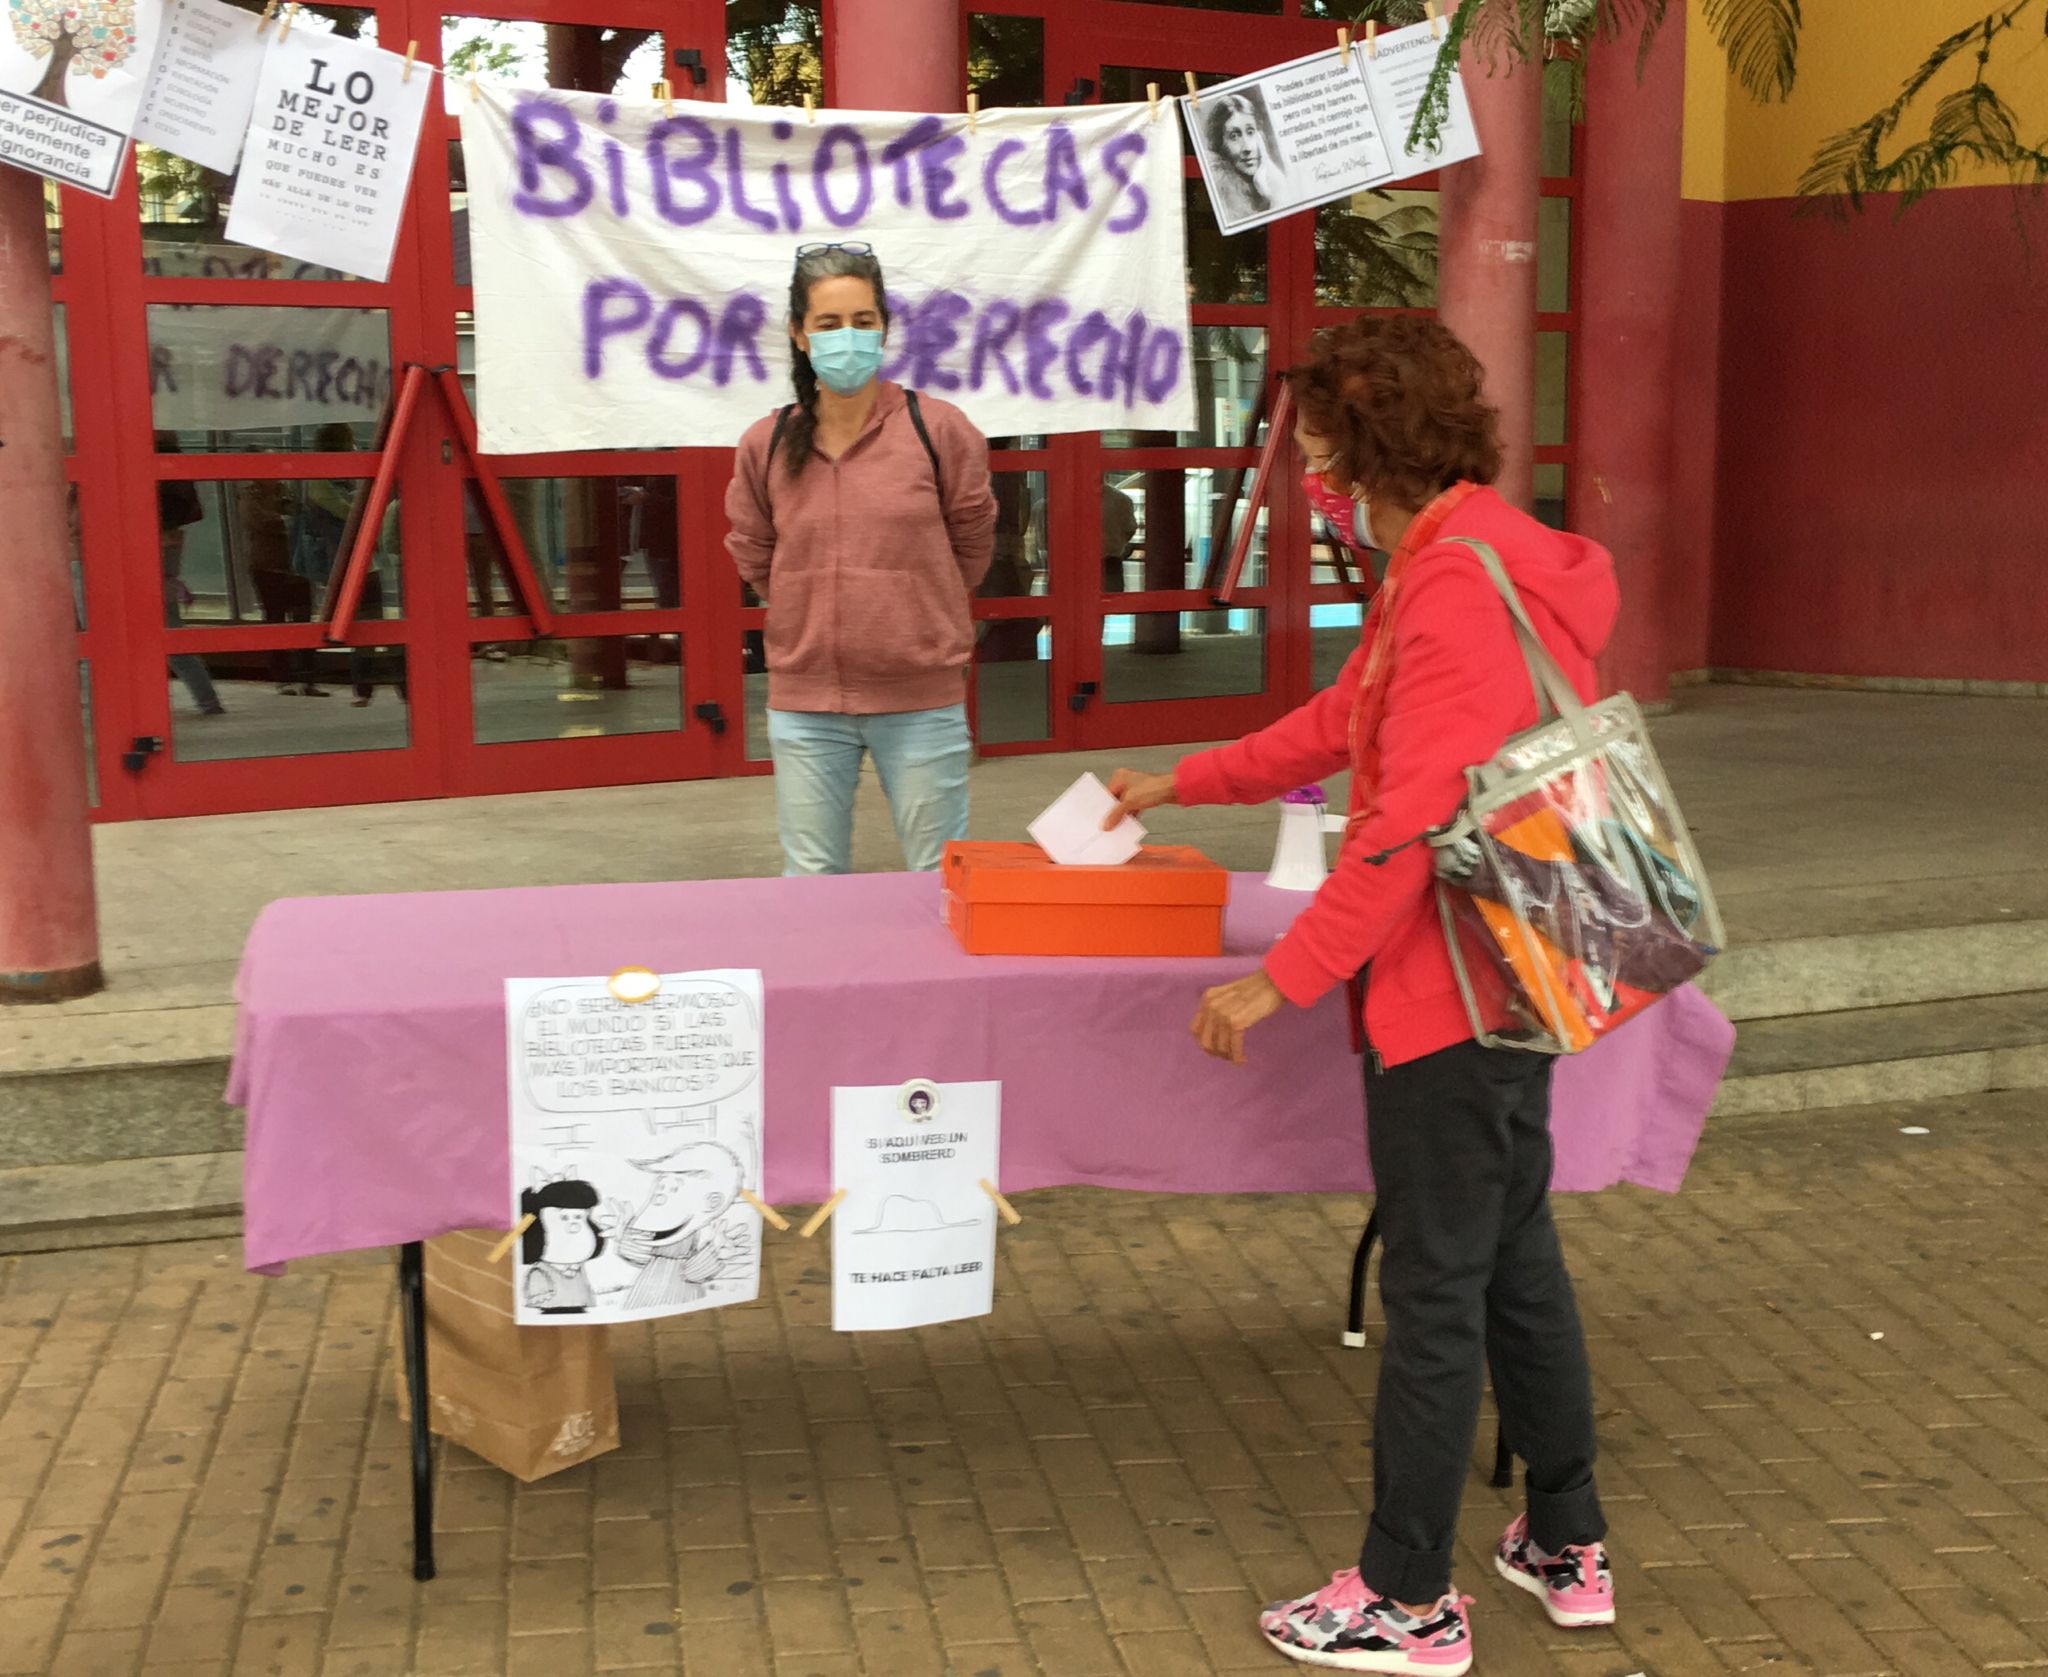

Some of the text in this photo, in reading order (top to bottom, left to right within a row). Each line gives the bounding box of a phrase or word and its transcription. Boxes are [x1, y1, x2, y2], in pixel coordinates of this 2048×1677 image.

[305, 58, 374, 105] LO
[0, 101, 107, 147] er perjudica
[277, 89, 389, 140] MEJOR
[0, 119, 91, 159] ravemente
[272, 115, 387, 161] DE LEER
[1, 140, 91, 178] gnorancia
[267, 139, 380, 179] MUCHO ES
[265, 160, 377, 198] QUE PUEDES VER
[581, 276, 769, 386] POR
[567, 1015, 647, 1035] MUNDO
[685, 1011, 727, 1029] LAS
[580, 1053, 718, 1075] IMPORTANTES
[557, 1079, 603, 1099] LOS
[879, 1147, 956, 1164] SOMBRERO
[948, 1131, 968, 1143] UN
[849, 1260, 983, 1283] TE HACE FALTA LEER
